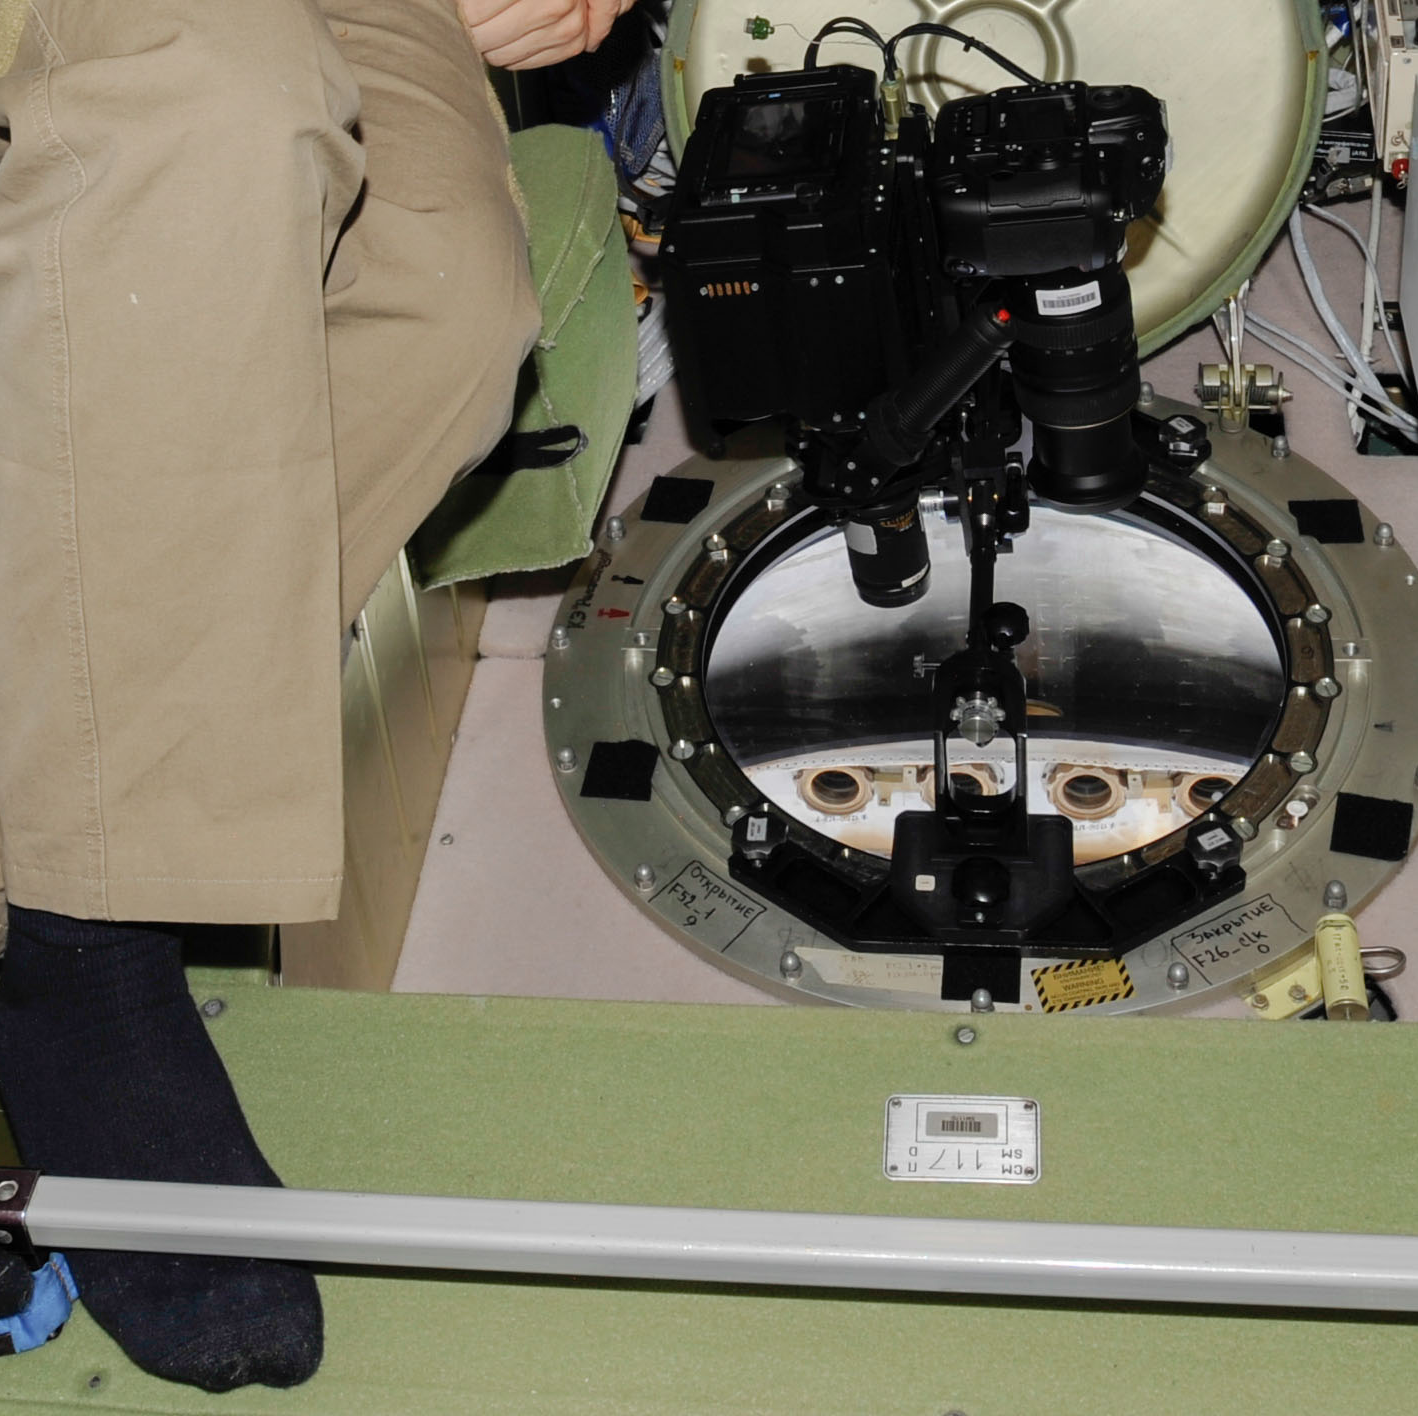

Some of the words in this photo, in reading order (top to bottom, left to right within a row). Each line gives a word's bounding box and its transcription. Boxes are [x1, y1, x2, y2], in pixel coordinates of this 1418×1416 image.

[928, 1148, 983, 1171] 117
[1001, 1164, 1023, 1175] СМ
[1001, 1148, 1023, 1159] SM
